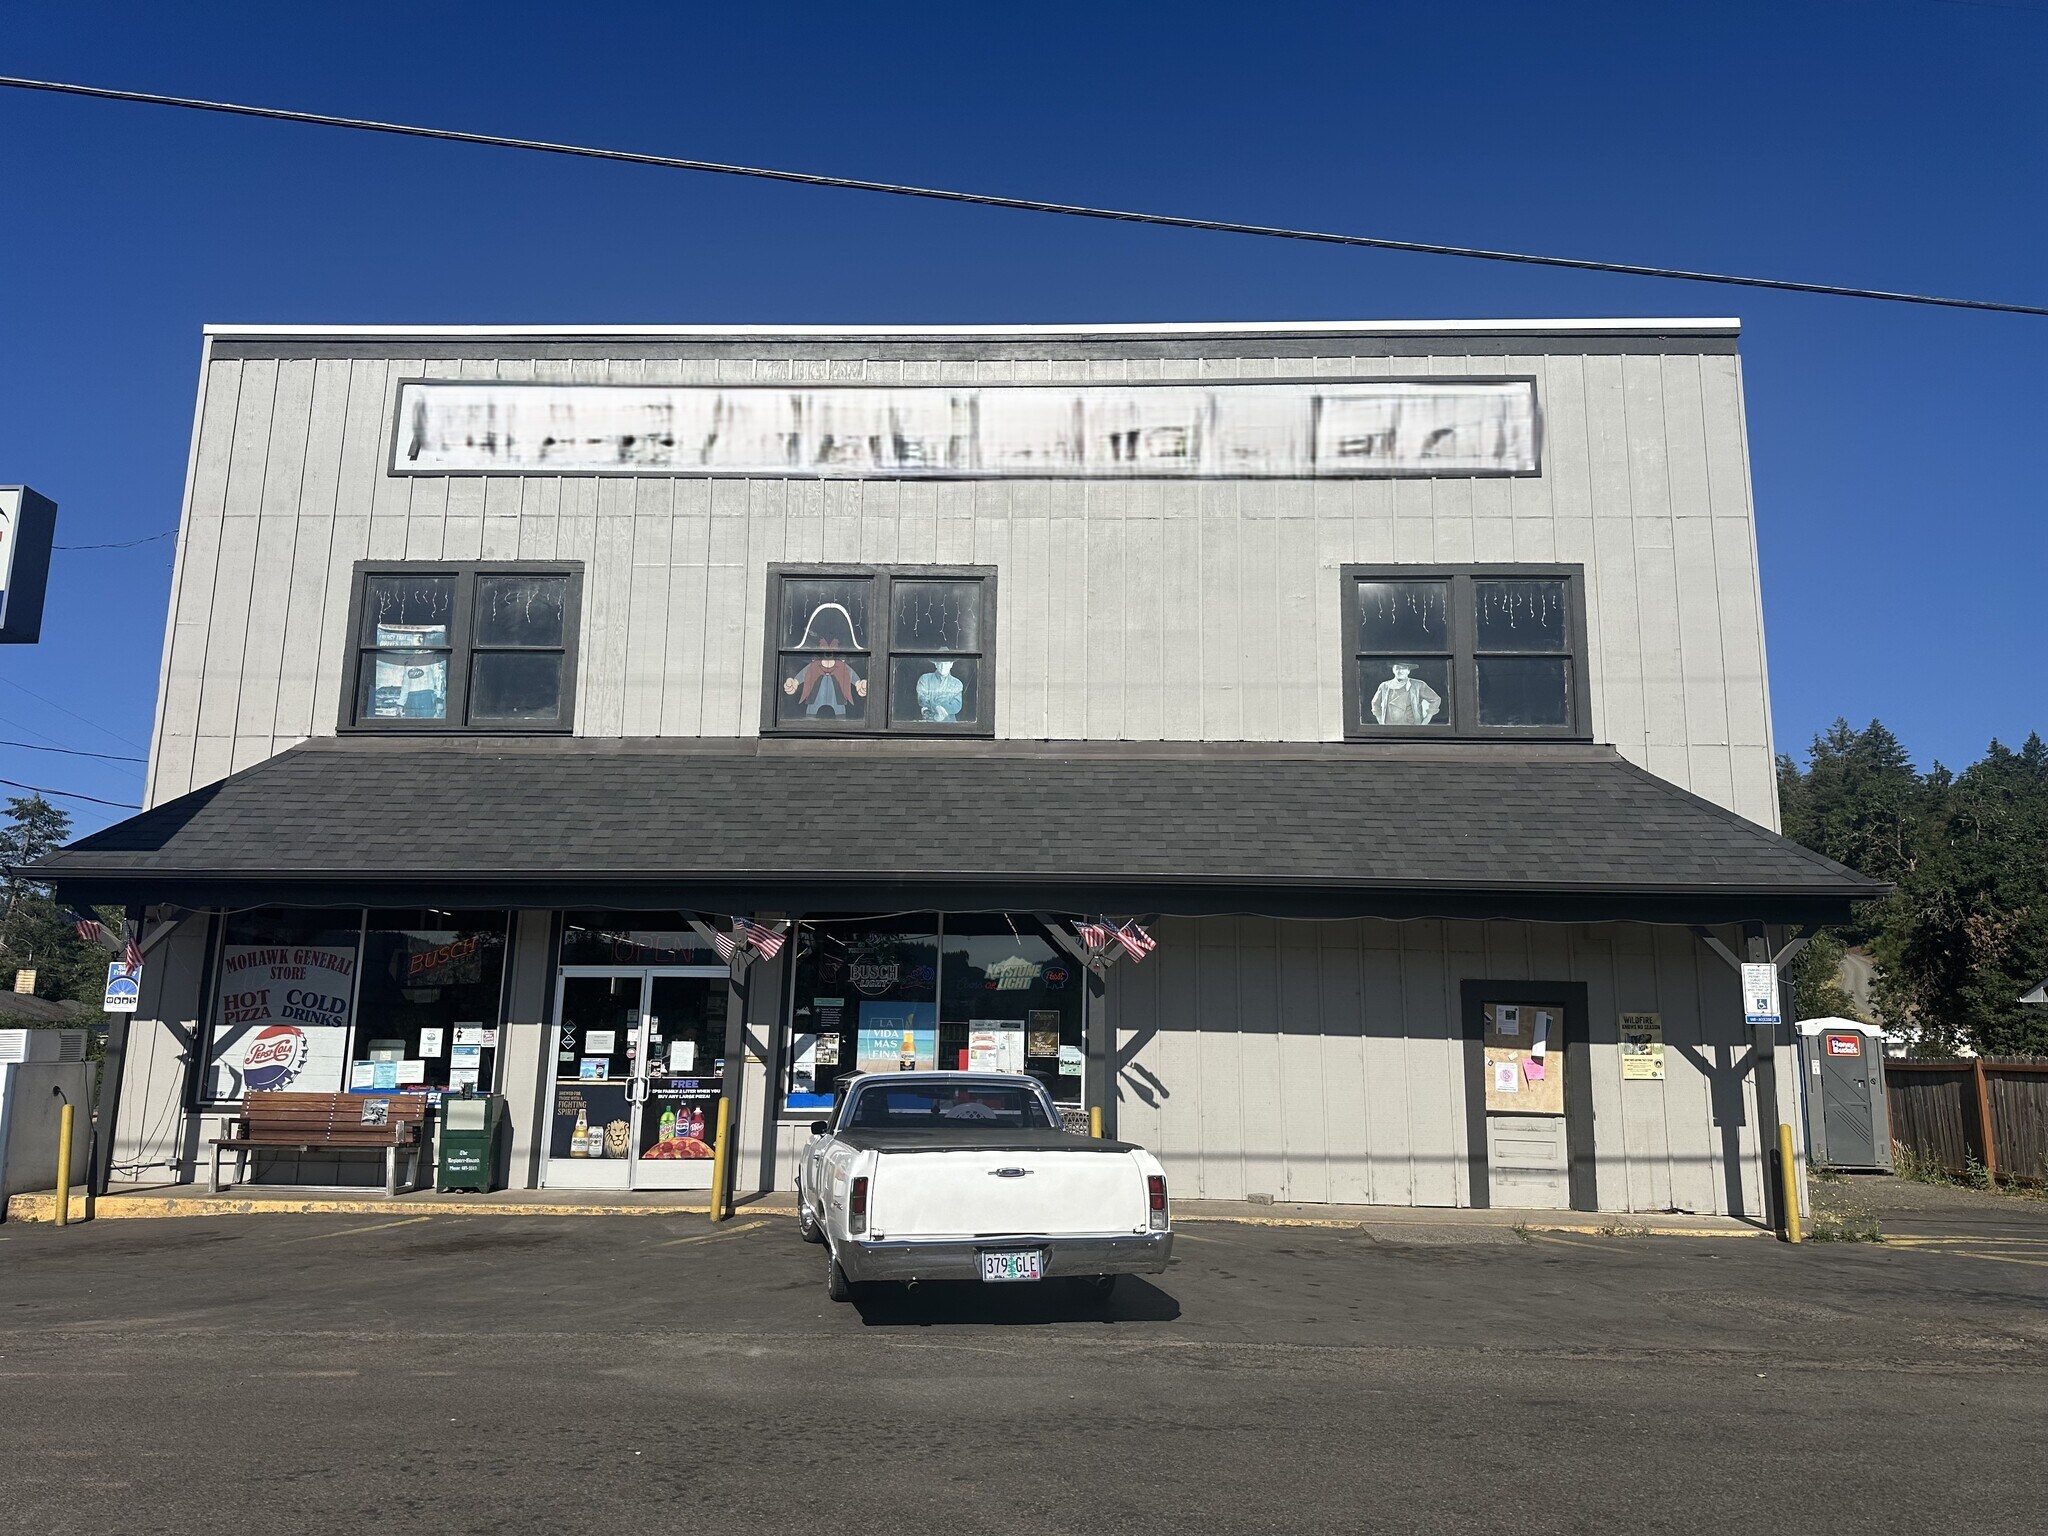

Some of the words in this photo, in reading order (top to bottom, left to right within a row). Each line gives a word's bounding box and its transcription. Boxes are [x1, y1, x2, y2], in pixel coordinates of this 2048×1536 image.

[225, 949, 289, 973] MOHAWK
[294, 949, 353, 976] GENERAL
[409, 936, 477, 974] BUSCH
[270, 967, 306, 980] STORE
[849, 964, 899, 980] BUSCH
[984, 964, 1043, 980] KEYSTONE
[997, 978, 1033, 990] LIGHT
[224, 989, 270, 1011] HOT
[286, 989, 347, 1014] COLD
[224, 1006, 272, 1024] PIZZA
[281, 1005, 343, 1027] DRINKS
[1623, 1016, 1653, 1024] WILDFIRE
[1831, 1040, 1855, 1049] Honey
[671, 1080, 699, 1088] FREE
[987, 1258, 1008, 1273] 379
[1016, 1256, 1037, 1273] GLE
